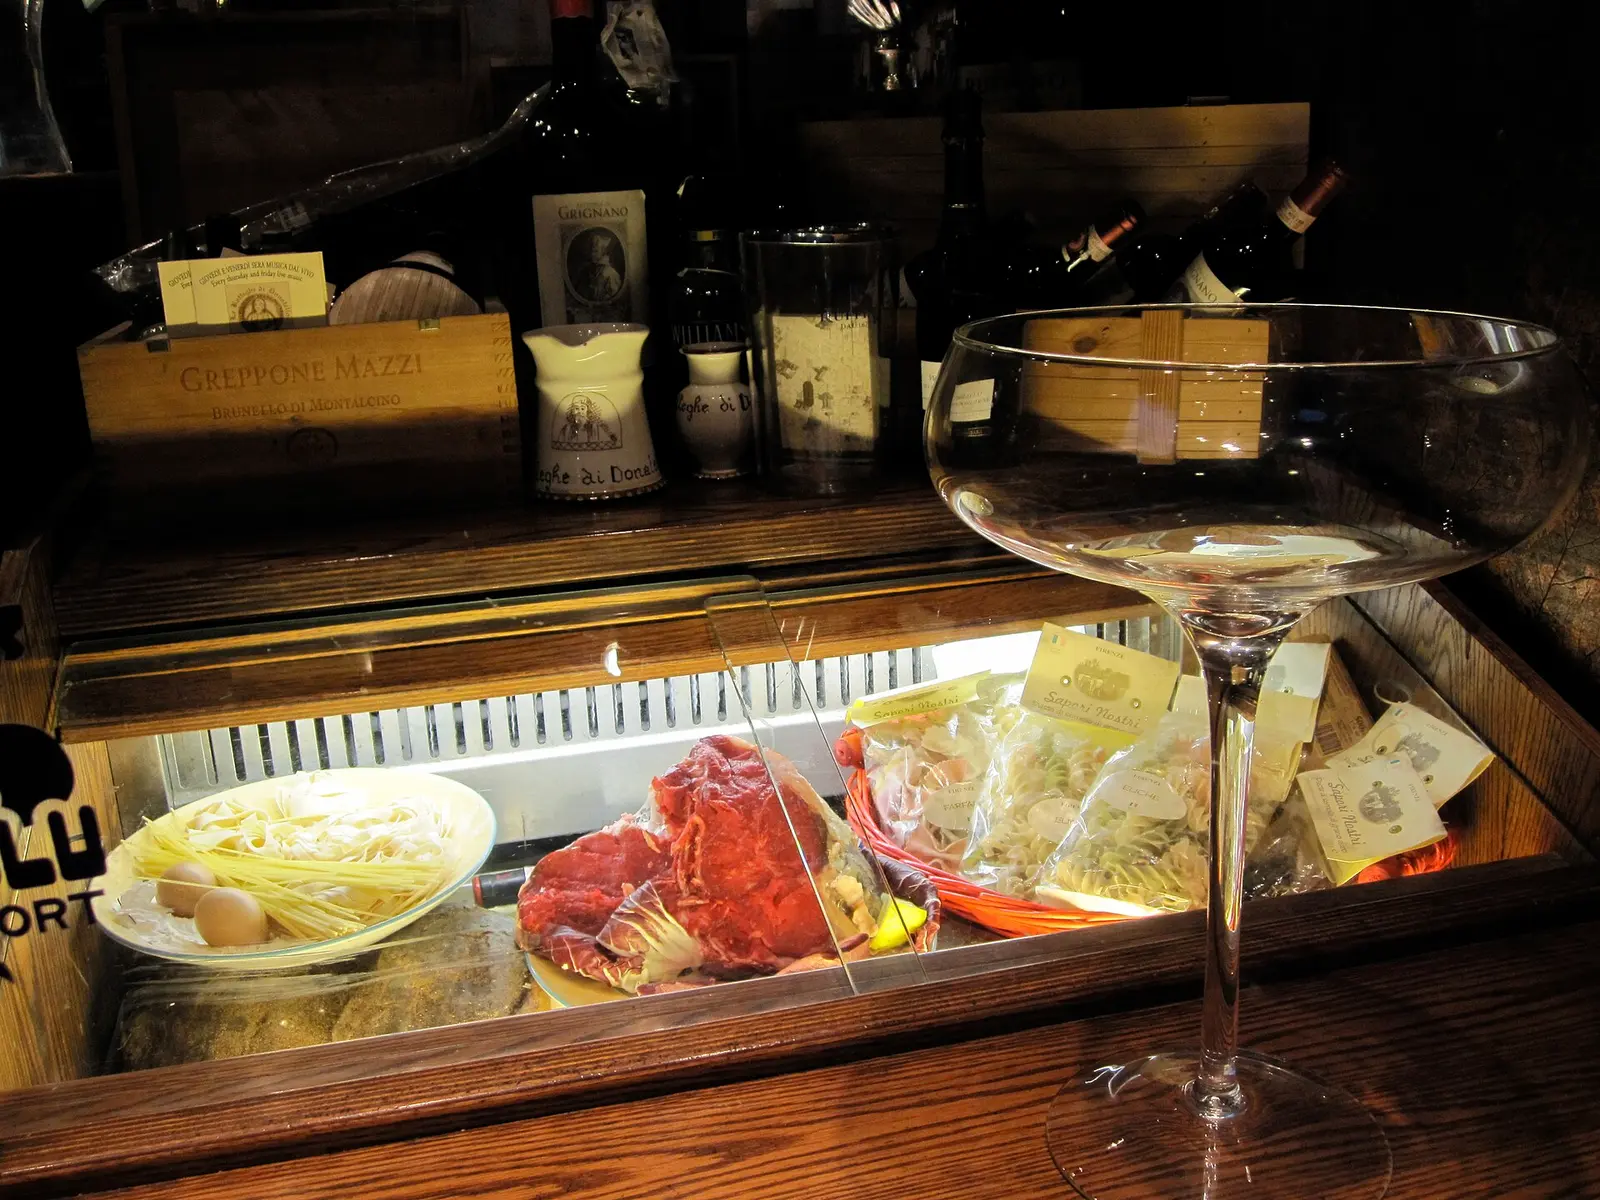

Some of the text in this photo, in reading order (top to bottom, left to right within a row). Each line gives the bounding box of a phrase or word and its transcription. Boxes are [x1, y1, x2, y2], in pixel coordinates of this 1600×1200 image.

[558, 205, 628, 220] GRIGNANO
[211, 277, 226, 288] Every
[227, 271, 249, 283] thursday
[250, 270, 260, 278] and
[260, 269, 277, 279] friday
[277, 270, 285, 278] live
[251, 261, 266, 269] SERA
[266, 261, 288, 270] MUSICA
[288, 263, 300, 272] DAL
[300, 265, 314, 278] VIVO
[179, 353, 423, 392] GREPPONE MAZZI
[212, 393, 401, 420] BRUNELLO DI MONTALCINO
[720, 393, 737, 412] di
[581, 467, 605, 485] di
[1095, 646, 1125, 660] FIRENZE
[873, 695, 959, 720] Sapori Nostri
[1043, 690, 1142, 729] Sapori Nostri
[1328, 780, 1354, 814] Sapori
[1341, 812, 1366, 846] Nostri
